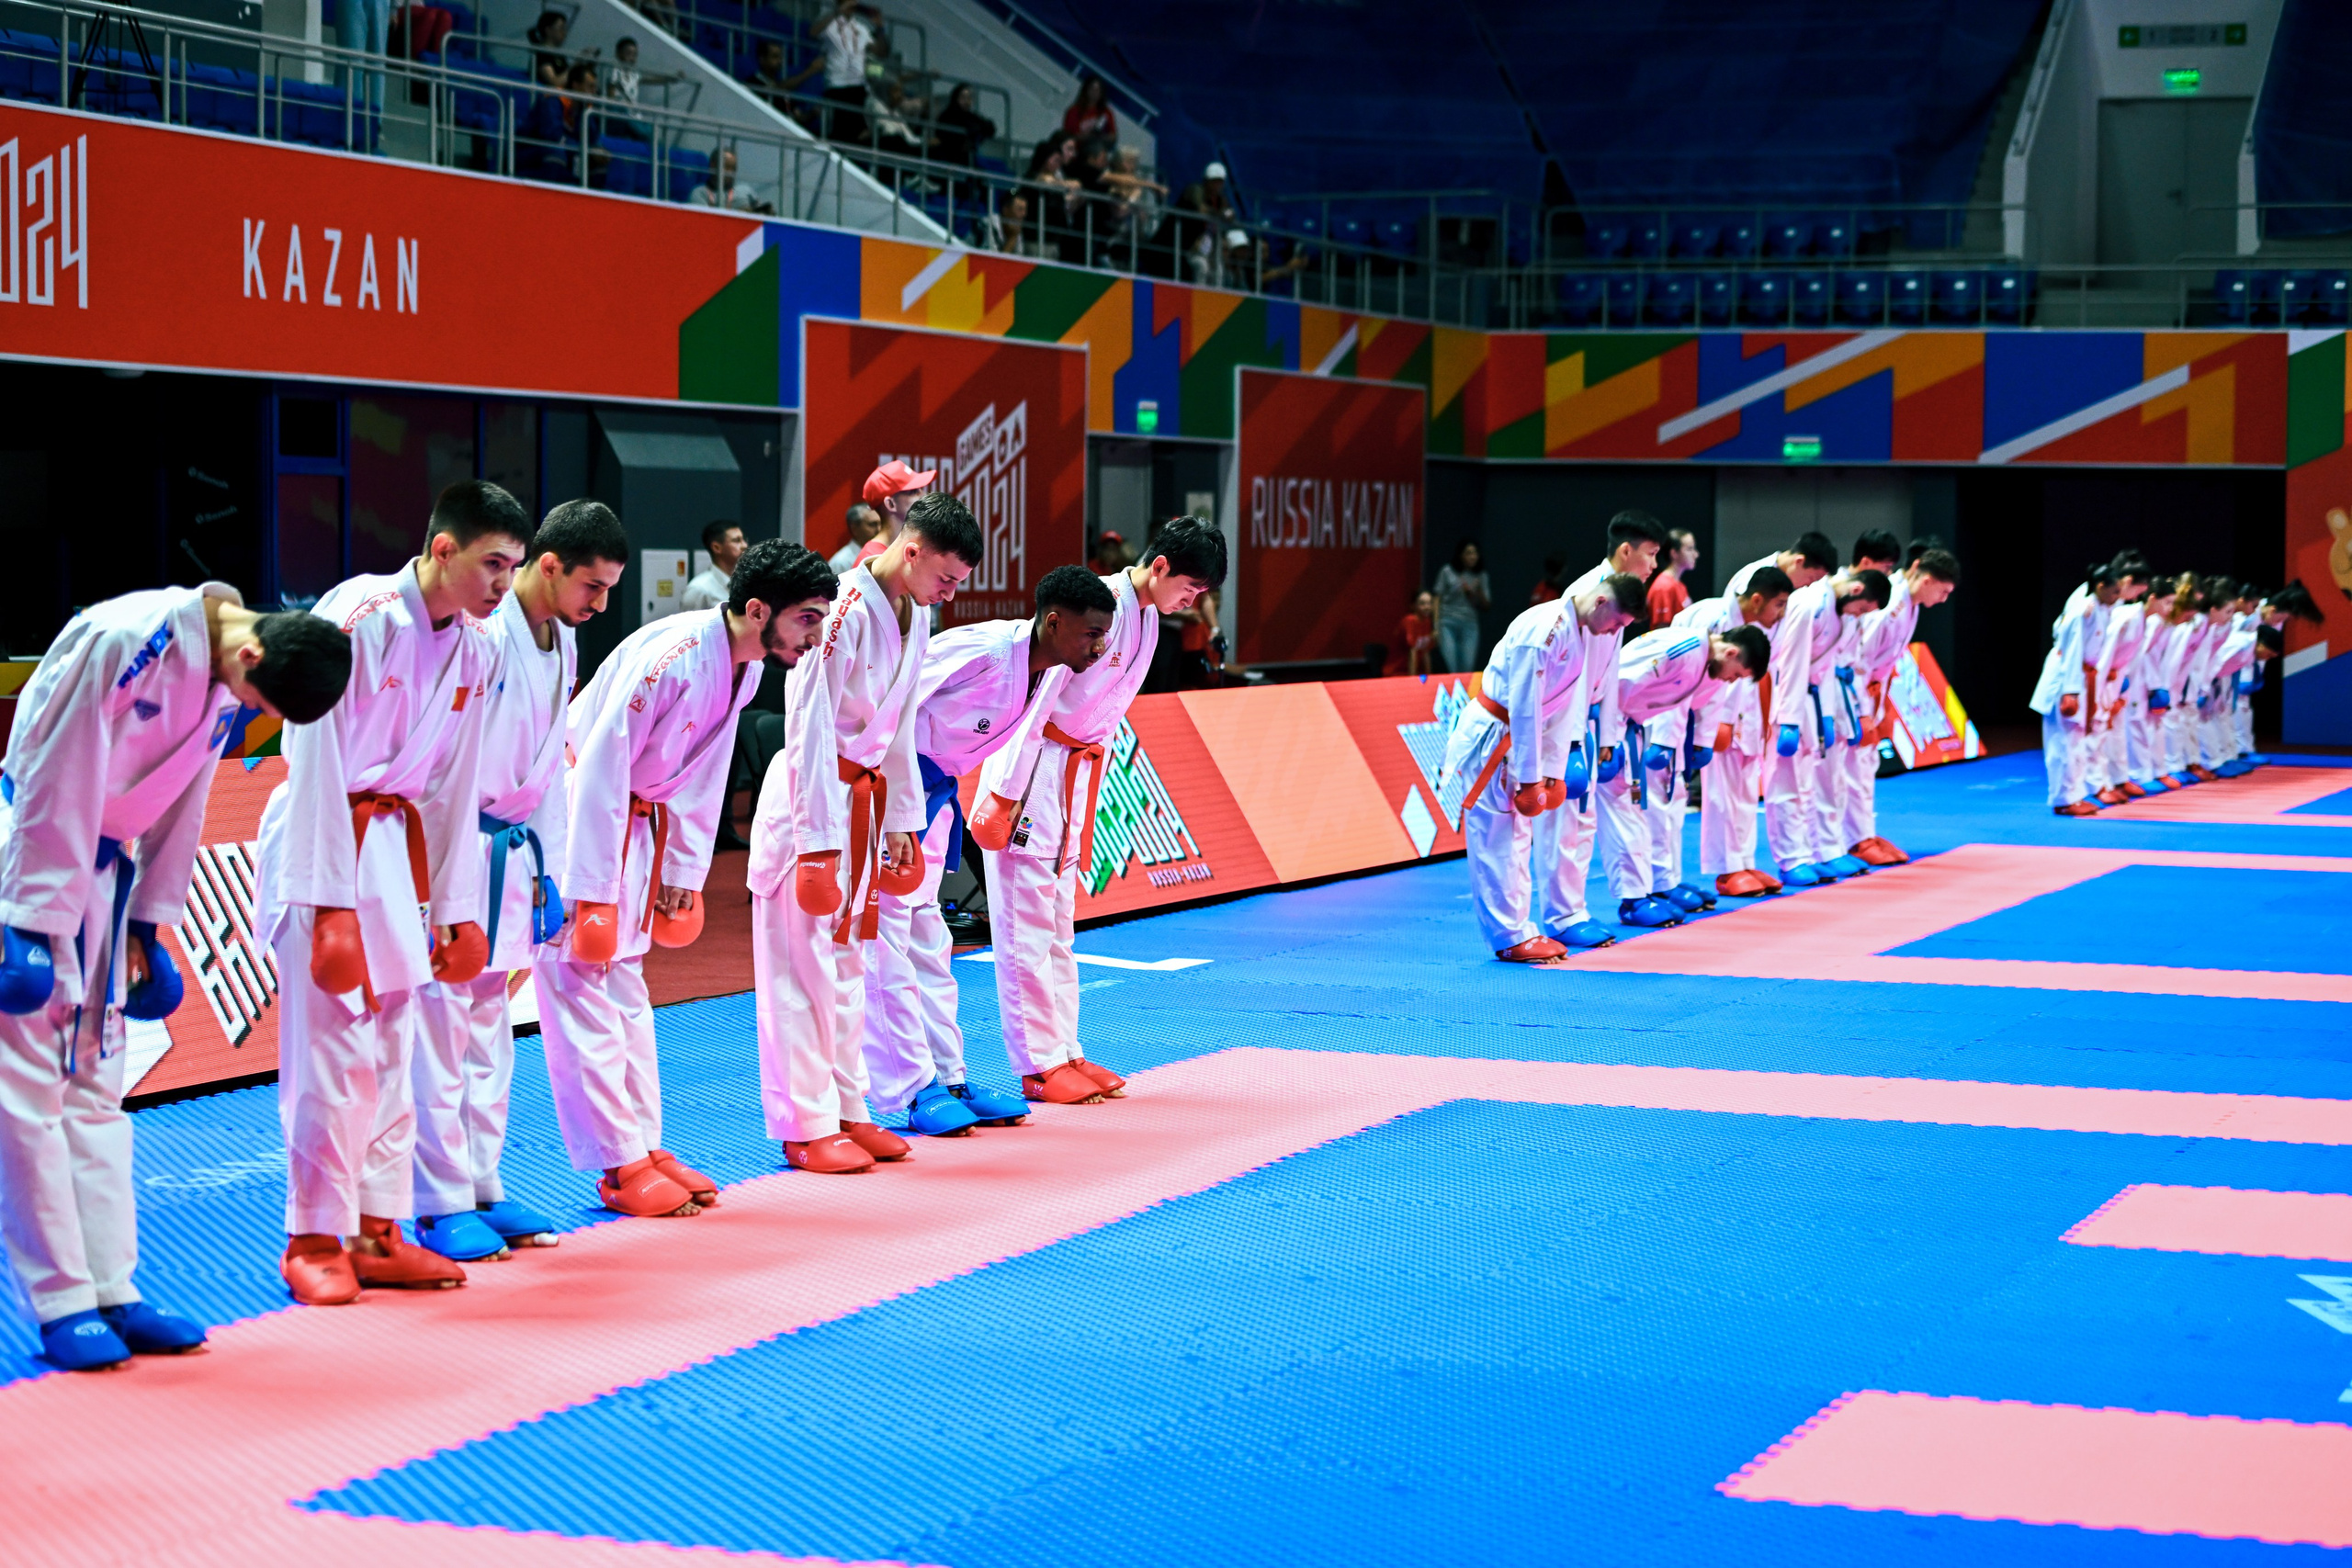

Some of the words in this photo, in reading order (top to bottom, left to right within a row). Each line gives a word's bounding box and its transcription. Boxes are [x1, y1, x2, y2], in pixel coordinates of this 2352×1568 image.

[243, 217, 418, 315] KAZAN
[1250, 475, 1336, 548] RUSSIA
[1341, 479, 1414, 548] KAZAN
